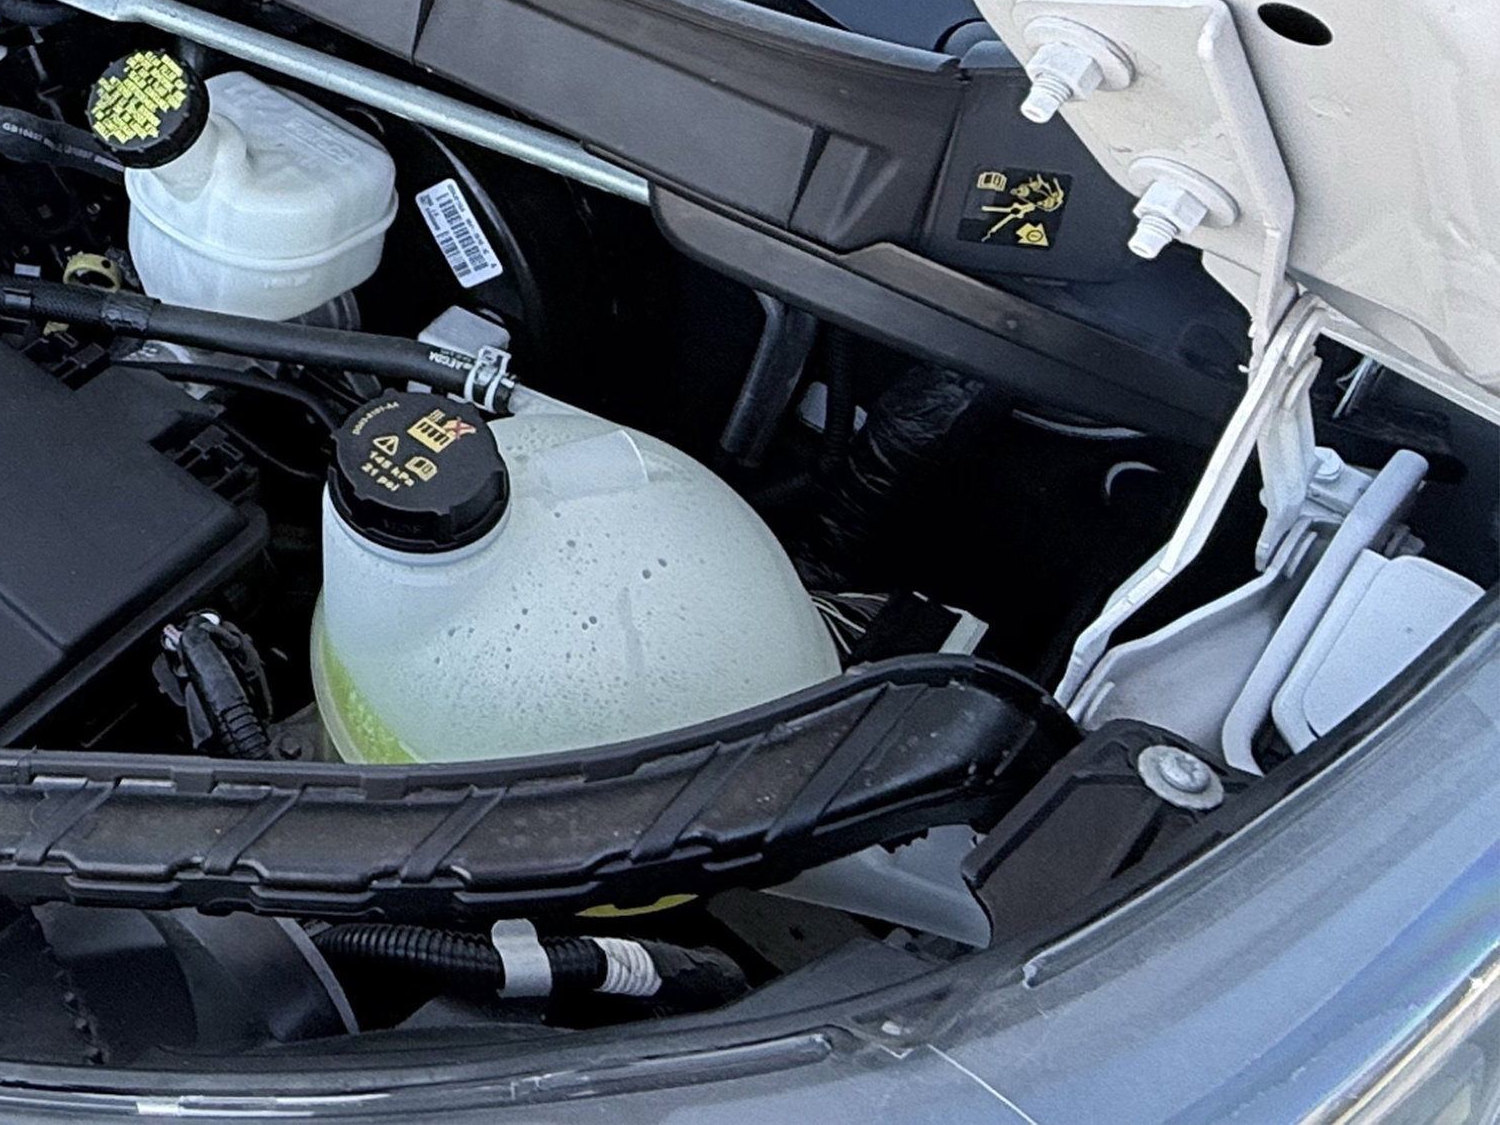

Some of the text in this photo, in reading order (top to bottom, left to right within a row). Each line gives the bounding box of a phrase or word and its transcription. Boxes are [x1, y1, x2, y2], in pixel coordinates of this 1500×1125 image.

[361, 463, 400, 492] 21 psi
[369, 451, 415, 487] 145 kPa
